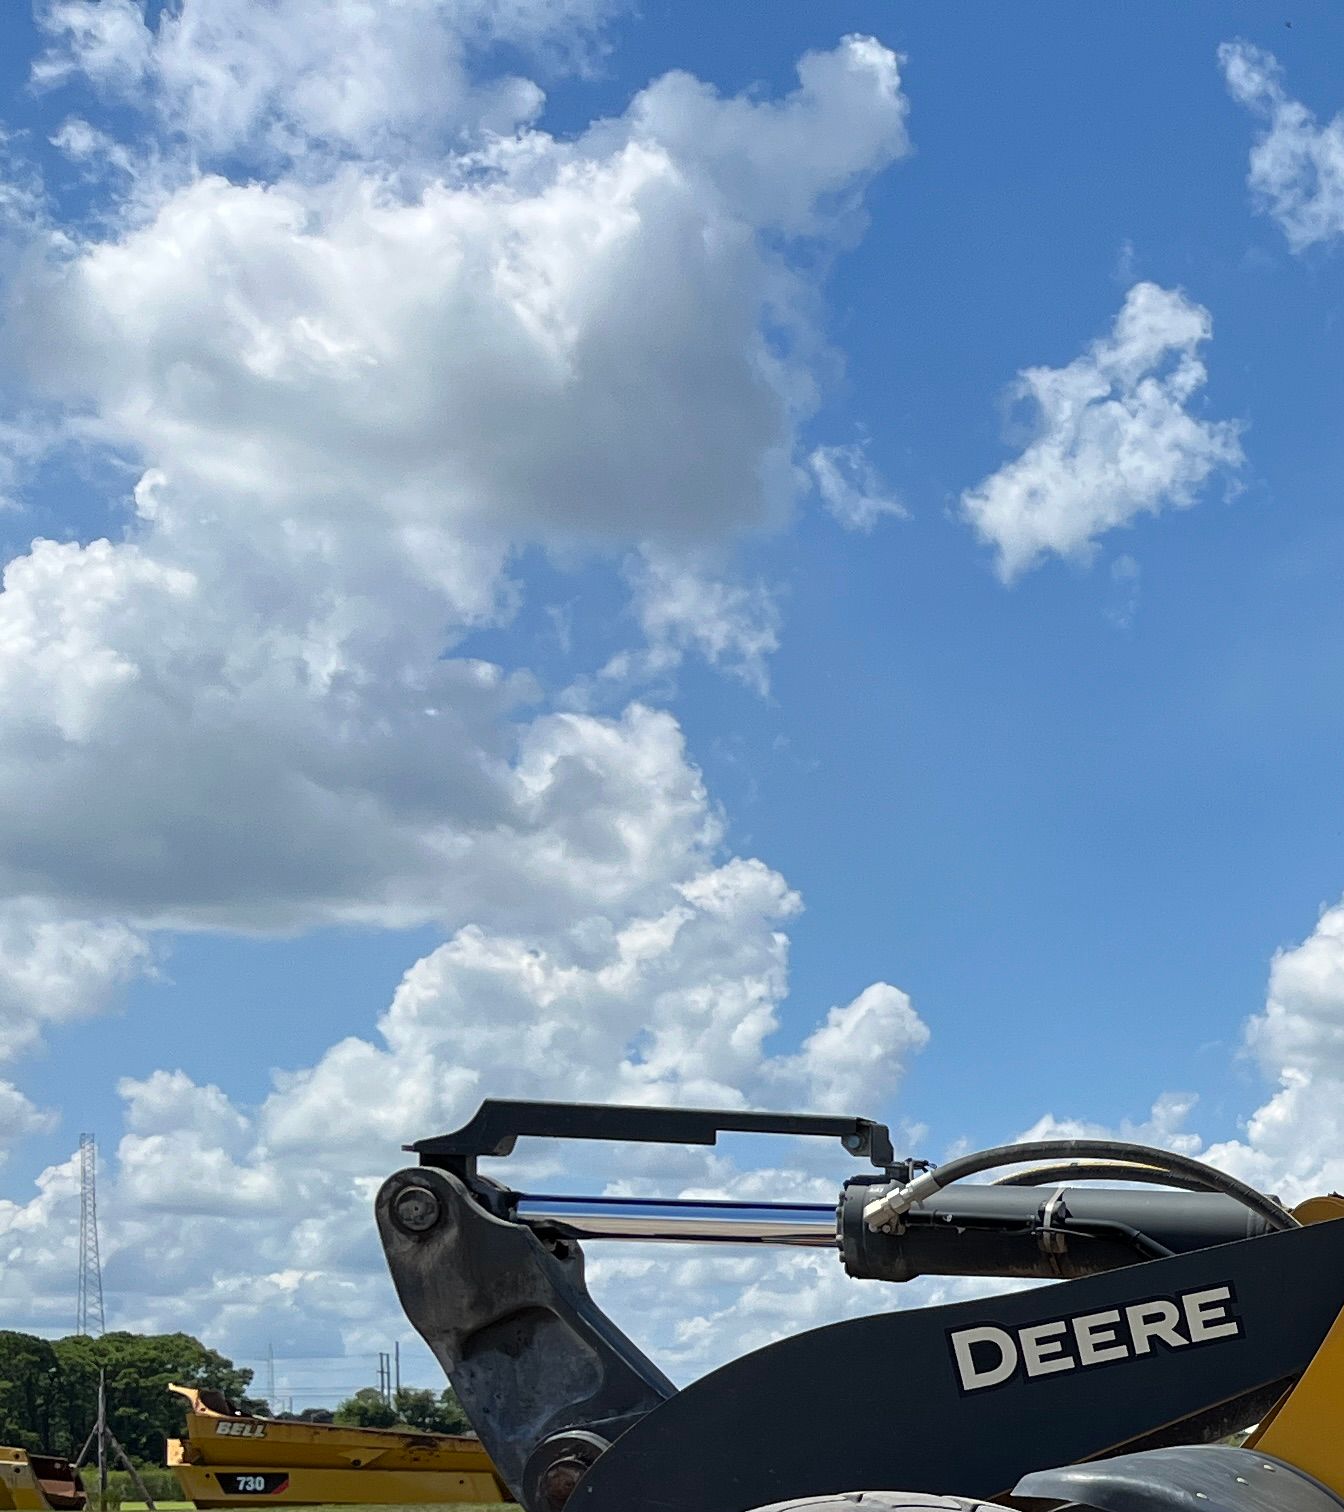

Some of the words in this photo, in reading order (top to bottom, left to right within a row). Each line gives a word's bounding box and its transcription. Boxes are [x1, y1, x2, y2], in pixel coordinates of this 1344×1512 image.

[951, 1286, 1239, 1391] DEERE
[216, 1421, 265, 1438] BELL
[236, 1476, 265, 1491] 730
